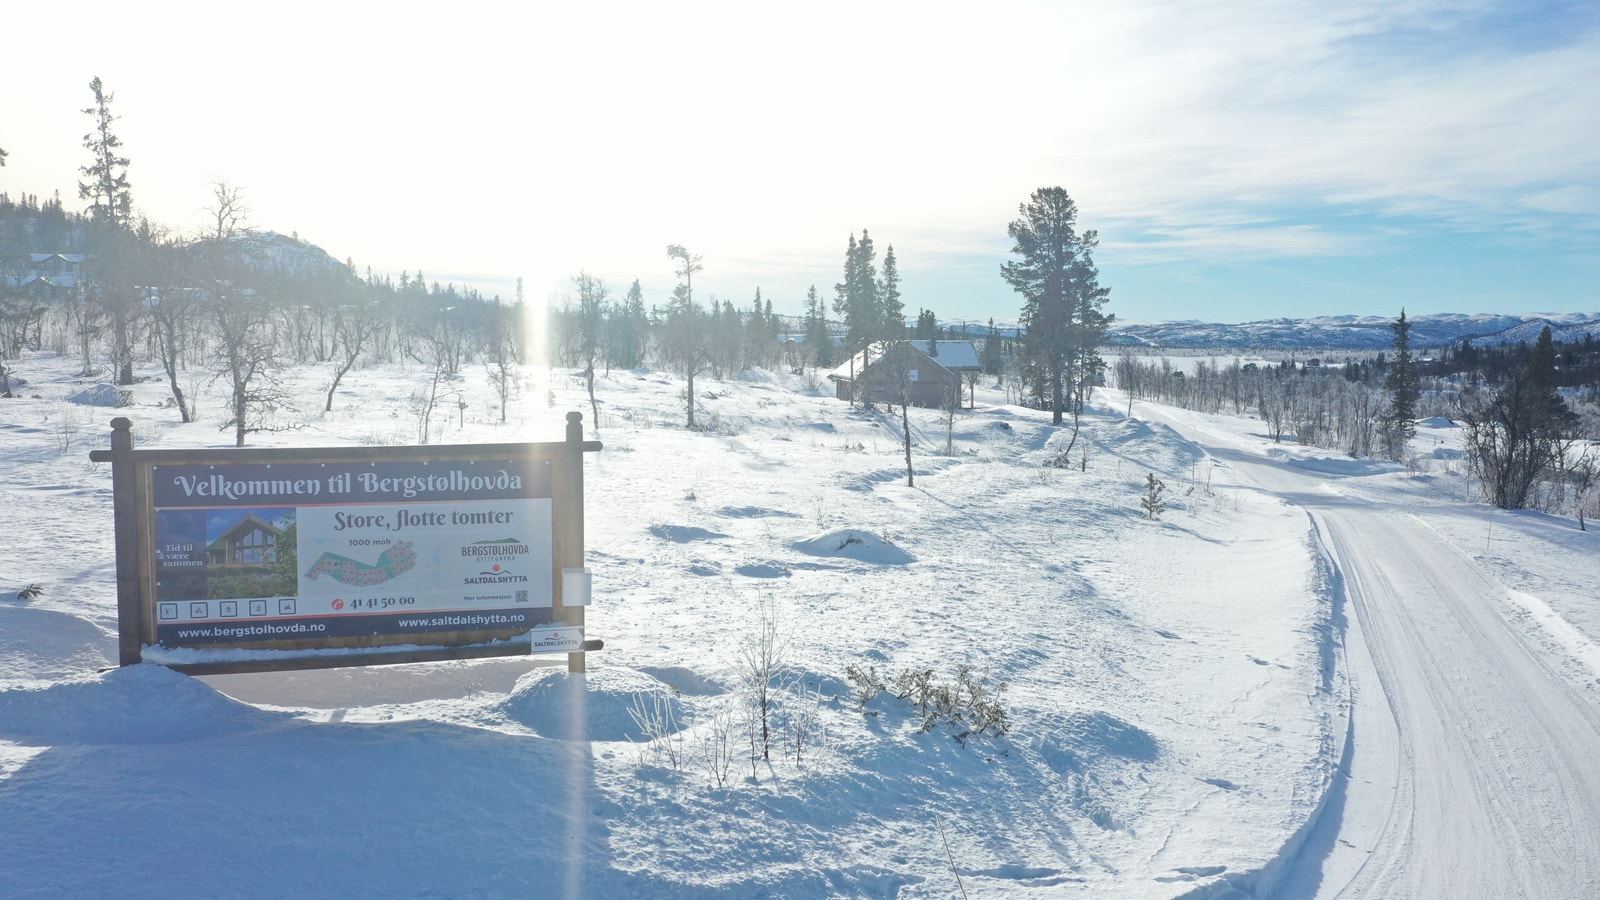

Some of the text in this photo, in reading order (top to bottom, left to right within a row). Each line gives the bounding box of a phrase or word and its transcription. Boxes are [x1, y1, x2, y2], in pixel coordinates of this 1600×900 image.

[174, 470, 522, 500] Velkommen til Bergstølhovda
[334, 509, 514, 532] Store, flotte tomter
[165, 543, 193, 552] Tid til
[349, 538, 392, 547] 1000 moh
[461, 544, 530, 557] BERGSTØLHOVDA
[464, 575, 528, 585] SALTDALSHYTTA
[350, 596, 415, 609] 41 41 50 00
[398, 613, 525, 628] www.saltdalshytta.no
[178, 623, 326, 638] www.bergstolhovda.no
[534, 639, 578, 648] SALTDALSHYTTA
